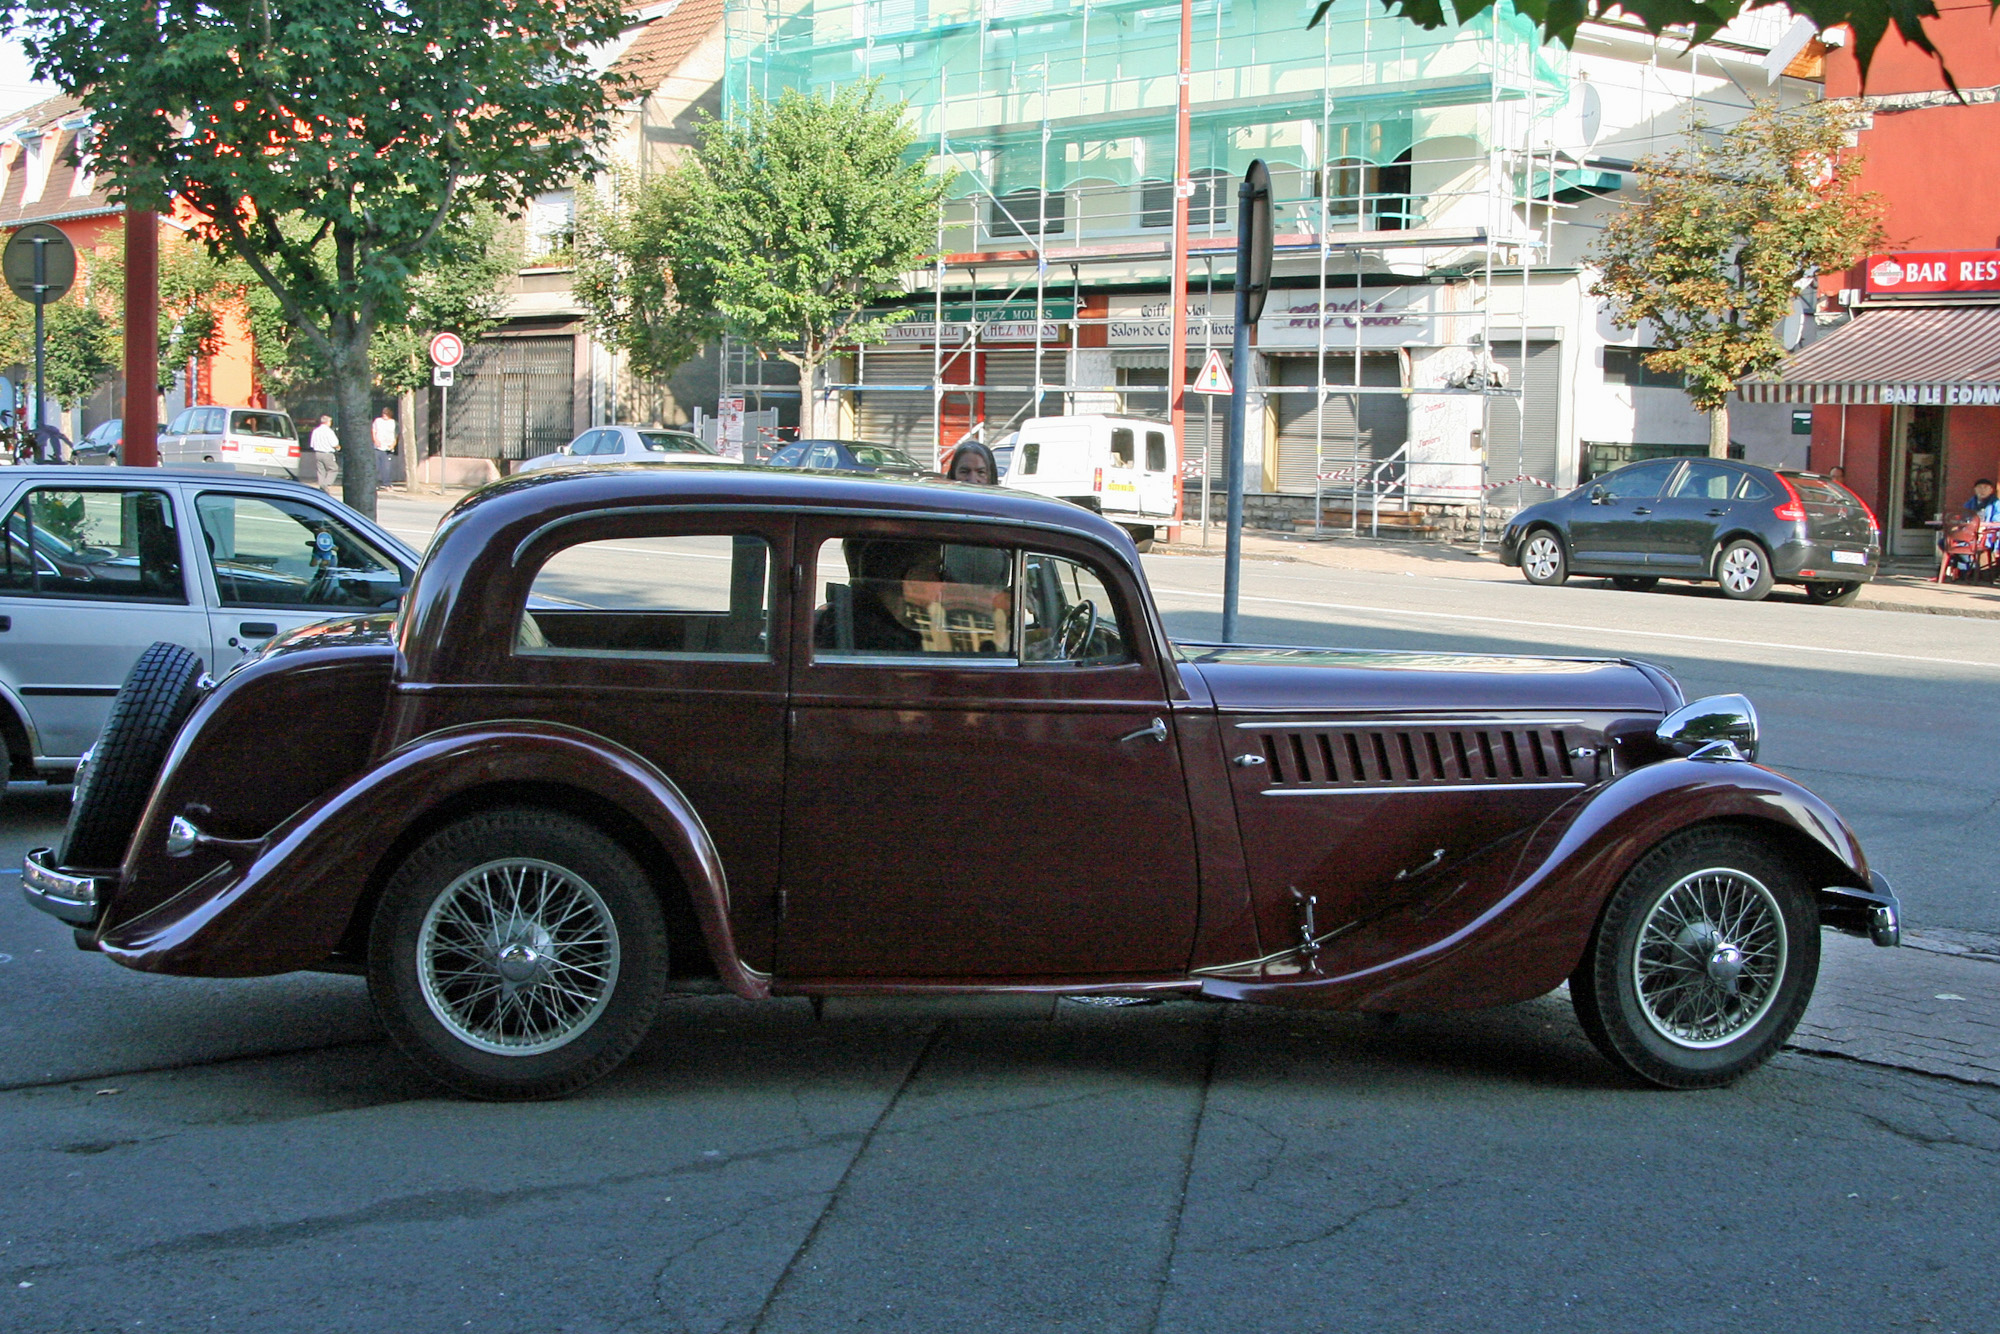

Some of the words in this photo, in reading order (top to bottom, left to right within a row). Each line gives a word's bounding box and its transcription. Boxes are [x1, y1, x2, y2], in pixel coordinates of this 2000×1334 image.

[1905, 262, 1947, 282] BAR
[1959, 260, 2000, 281] RES
[975, 310, 1007, 321] CHEZ
[982, 325, 1013, 337] CHEZ
[1111, 323, 1140, 337] Salon
[1143, 325, 1154, 337] de
[1884, 388, 1917, 403] BAR
[1924, 388, 1941, 404] LE
